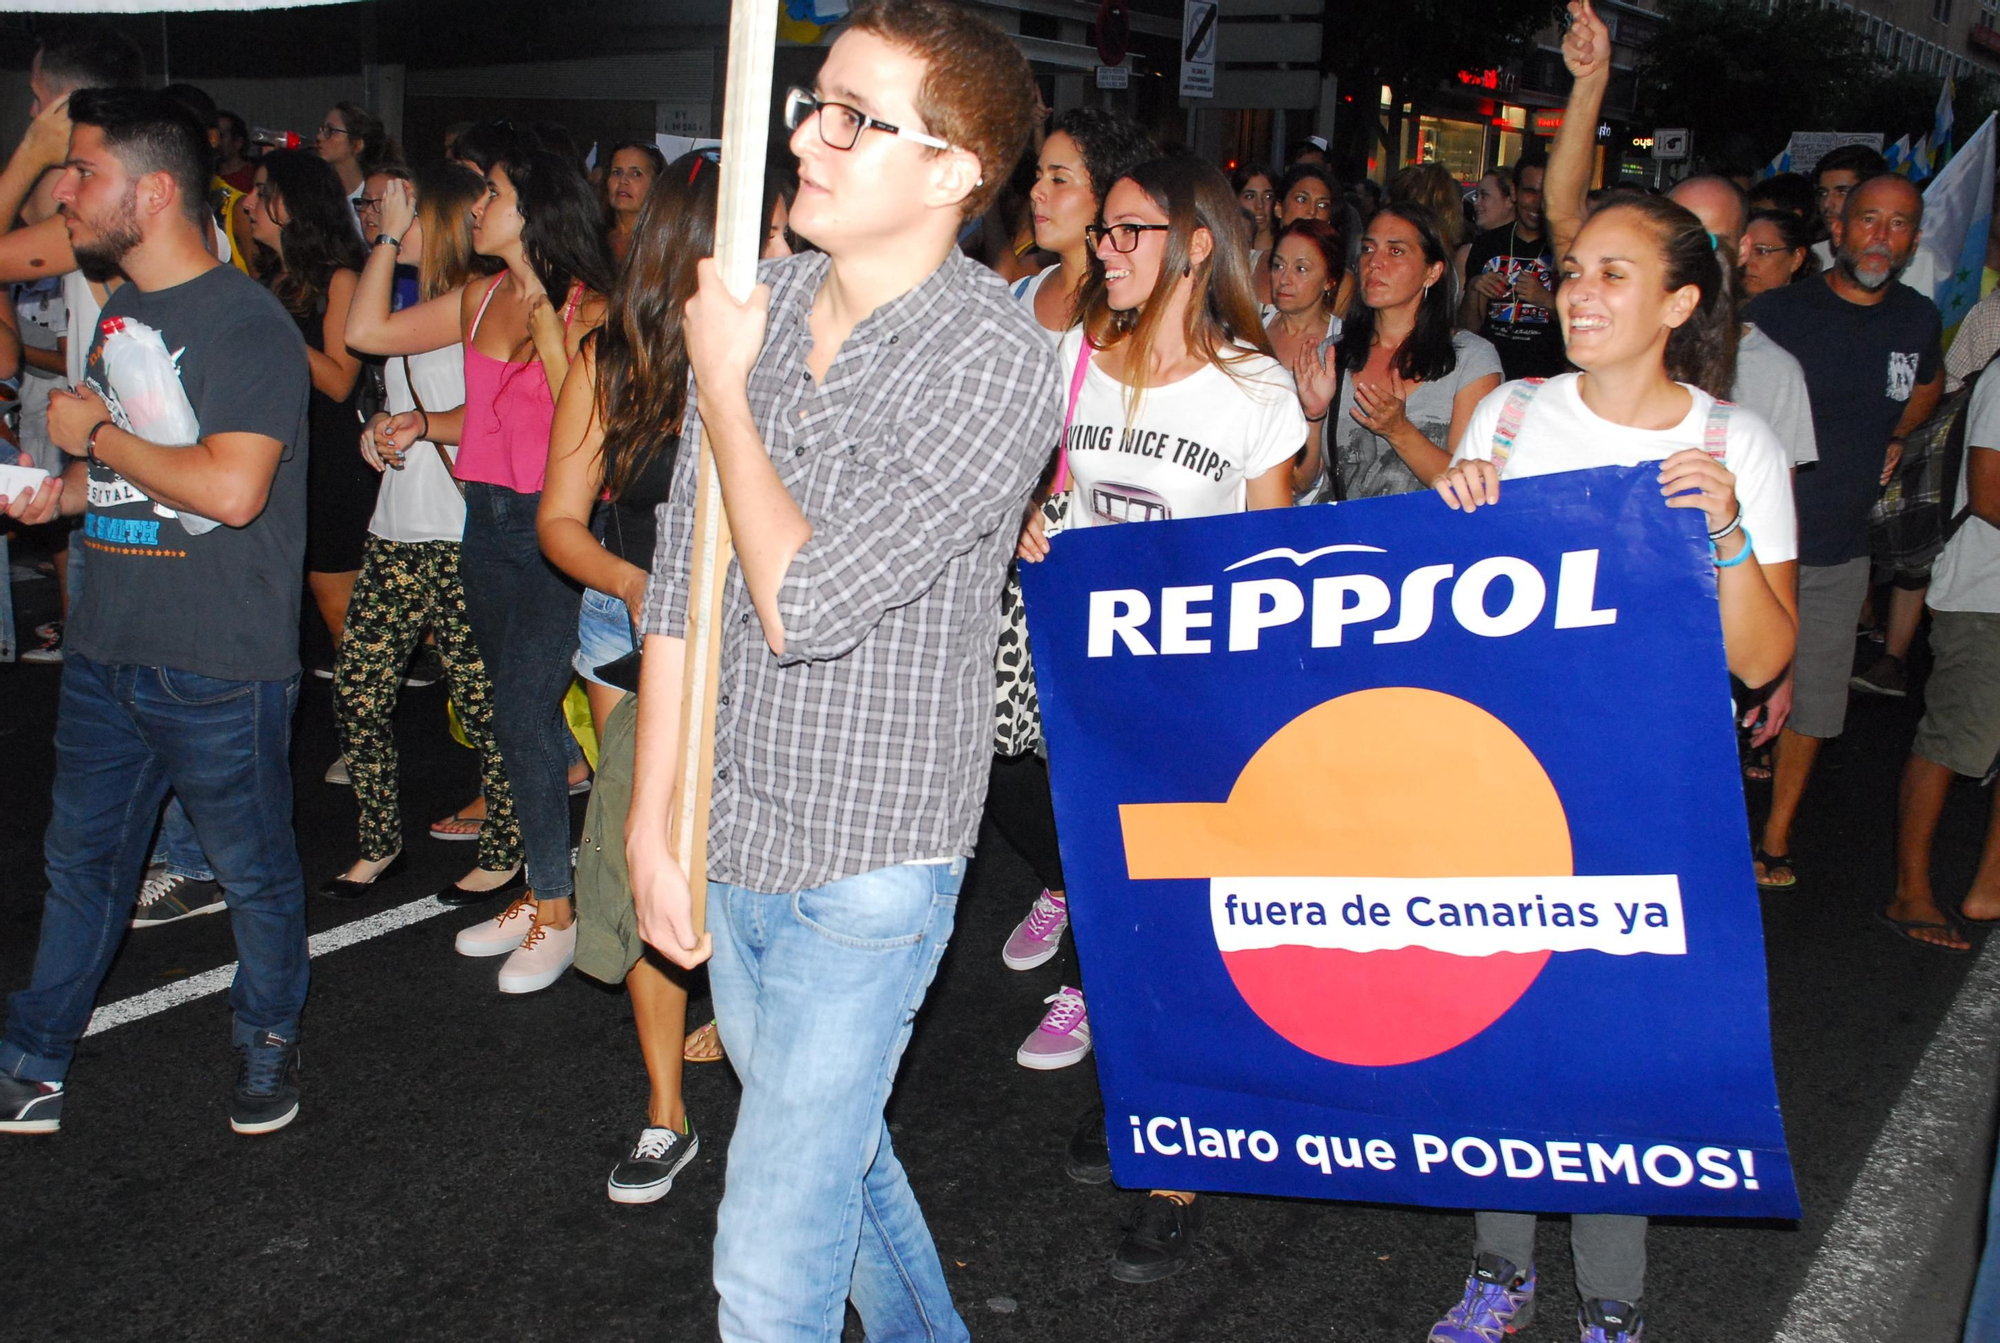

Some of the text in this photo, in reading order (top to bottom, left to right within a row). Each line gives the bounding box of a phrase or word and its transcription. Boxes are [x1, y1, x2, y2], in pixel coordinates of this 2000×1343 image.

[1118, 427, 1170, 459] NICE
[1172, 437, 1232, 482] TRIPS
[1087, 548, 1618, 658] REPPSOL
[1224, 894, 1669, 935] fuera de Canarias ya
[1129, 1115, 1760, 1190] ¡Claro que PODEMOS!
